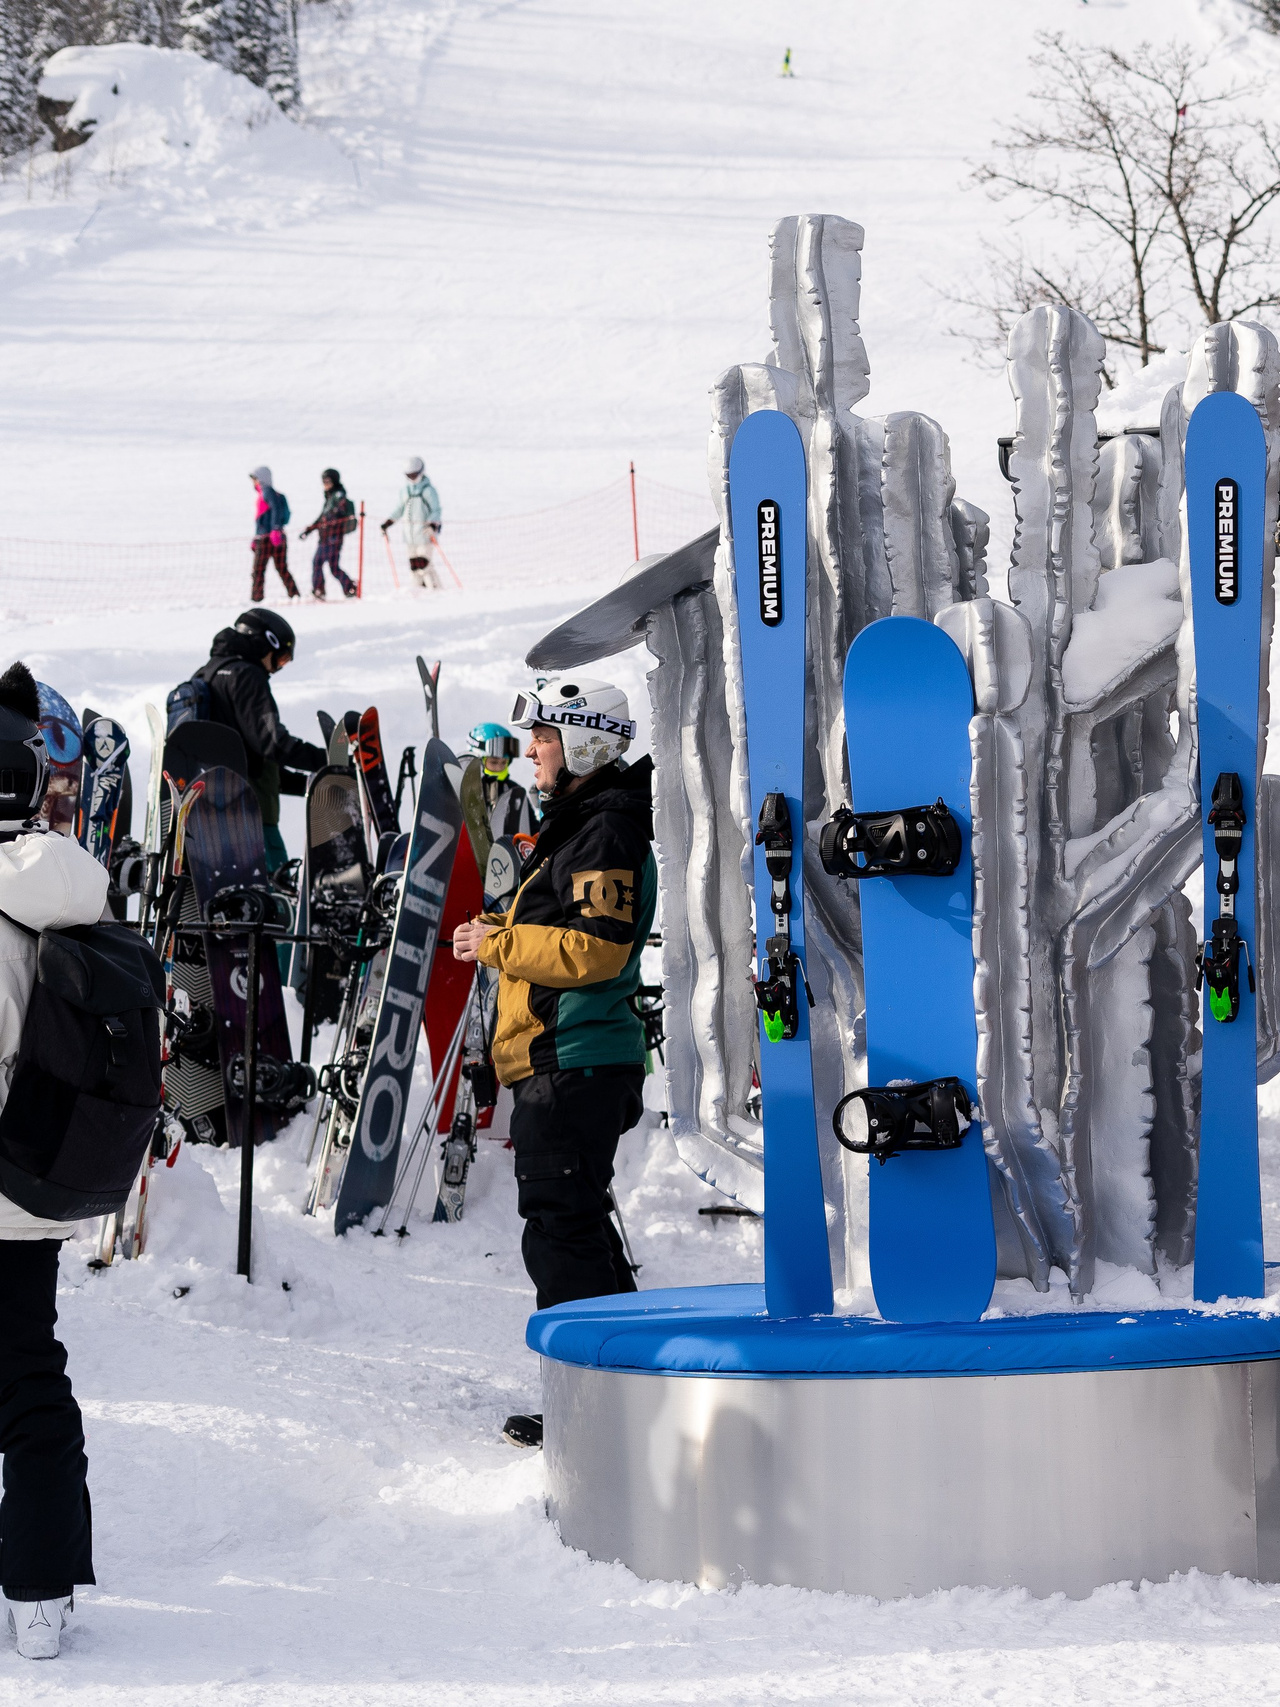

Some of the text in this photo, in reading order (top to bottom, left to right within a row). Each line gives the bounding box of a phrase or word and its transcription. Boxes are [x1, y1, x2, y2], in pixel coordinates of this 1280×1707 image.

[760, 506, 778, 619] PREMIUM
[1218, 485, 1234, 596] PREMIUM
[560, 698, 584, 709] oPro
[571, 868, 634, 924] DC
[360, 811, 456, 1162] NITRO
